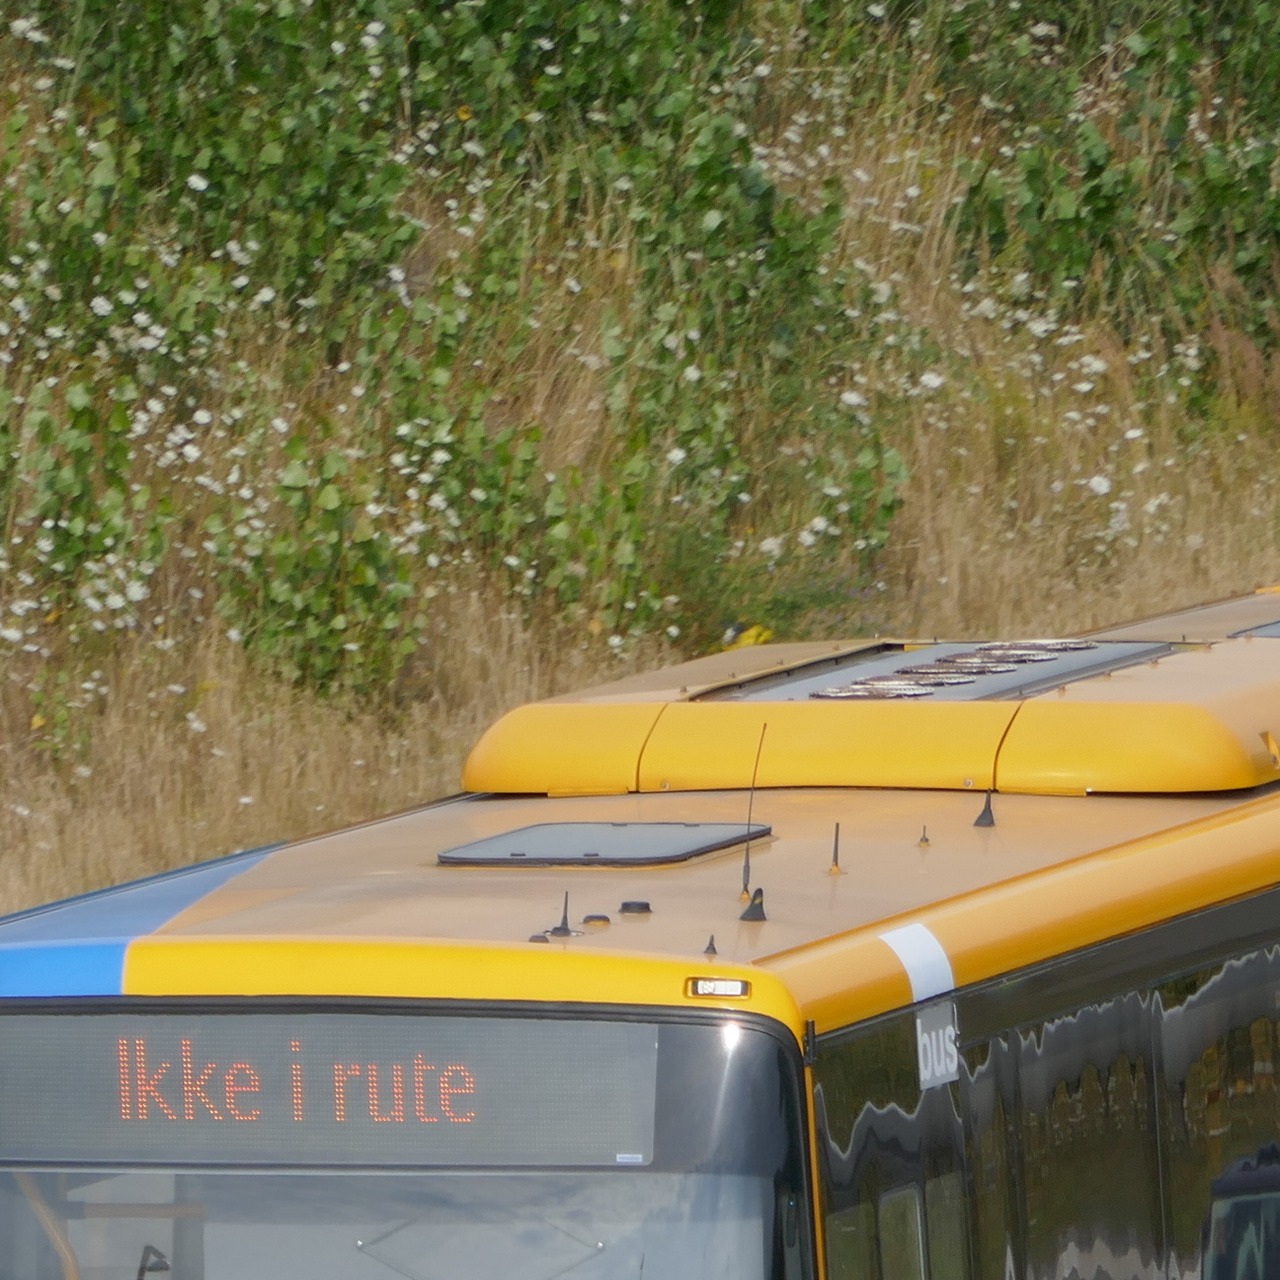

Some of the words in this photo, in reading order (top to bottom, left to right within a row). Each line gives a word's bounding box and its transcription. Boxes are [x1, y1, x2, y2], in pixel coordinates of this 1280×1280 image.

[118, 1038, 261, 1121] Ikke
[290, 1039, 303, 1122] i
[332, 1053, 476, 1123] rute
[916, 1018, 959, 1081] bus
